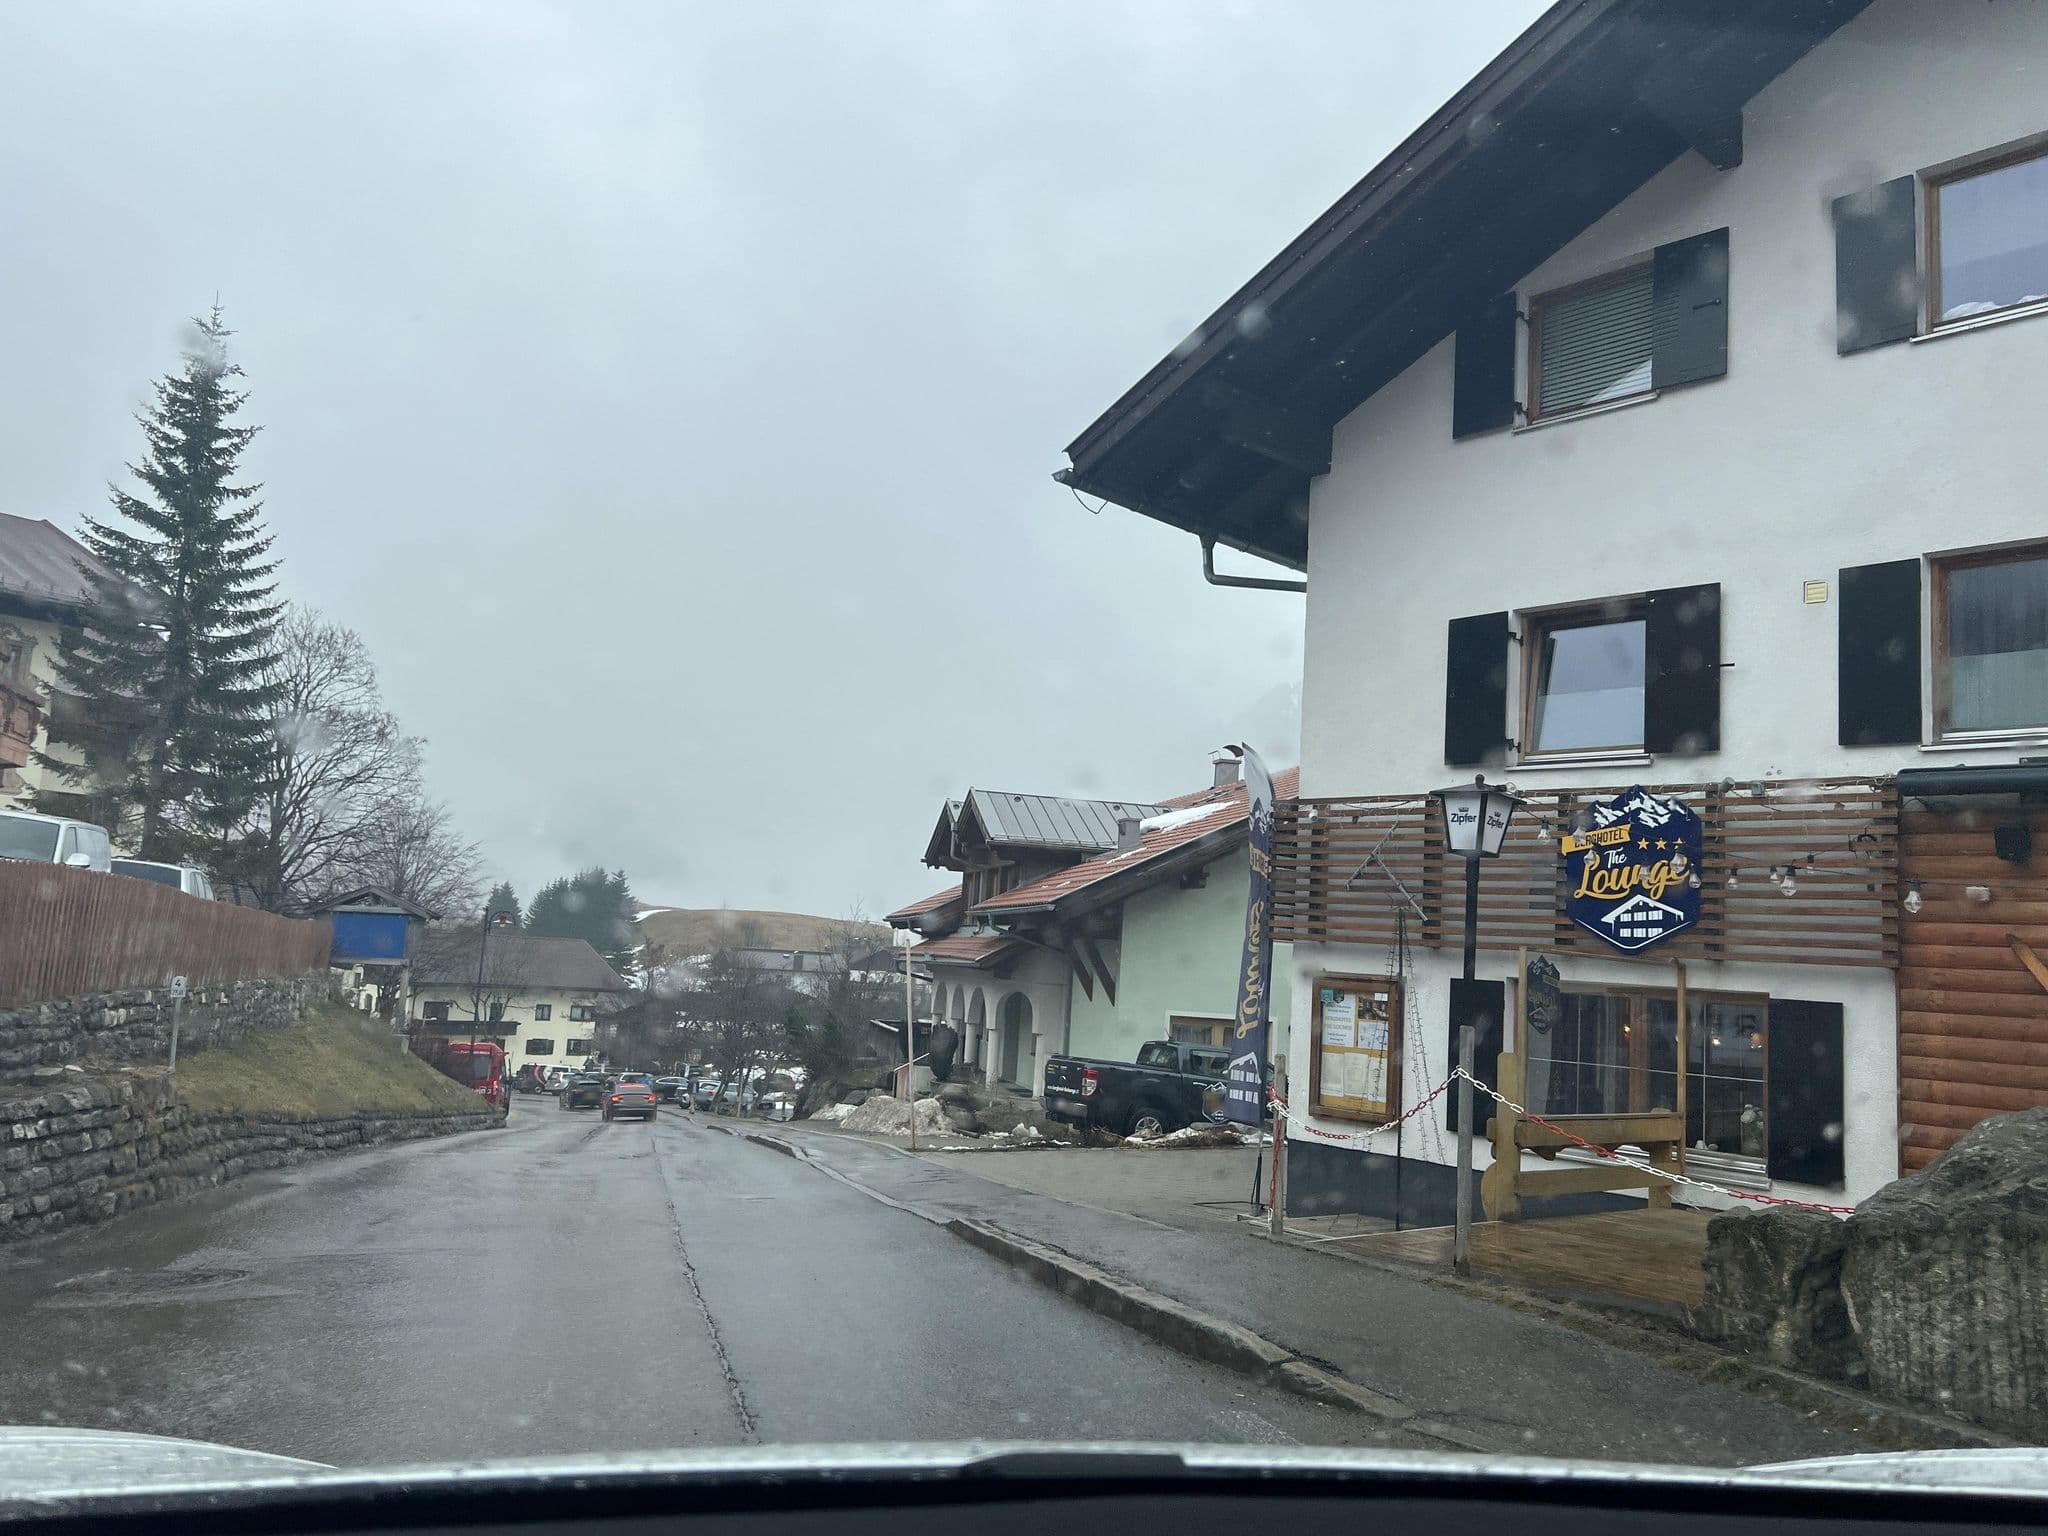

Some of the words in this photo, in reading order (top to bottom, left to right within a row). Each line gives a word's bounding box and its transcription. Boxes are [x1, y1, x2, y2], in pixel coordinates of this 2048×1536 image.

[1451, 813, 1477, 825] Zipfer
[1487, 816, 1504, 829] Zipfer
[1604, 847, 1627, 868] The
